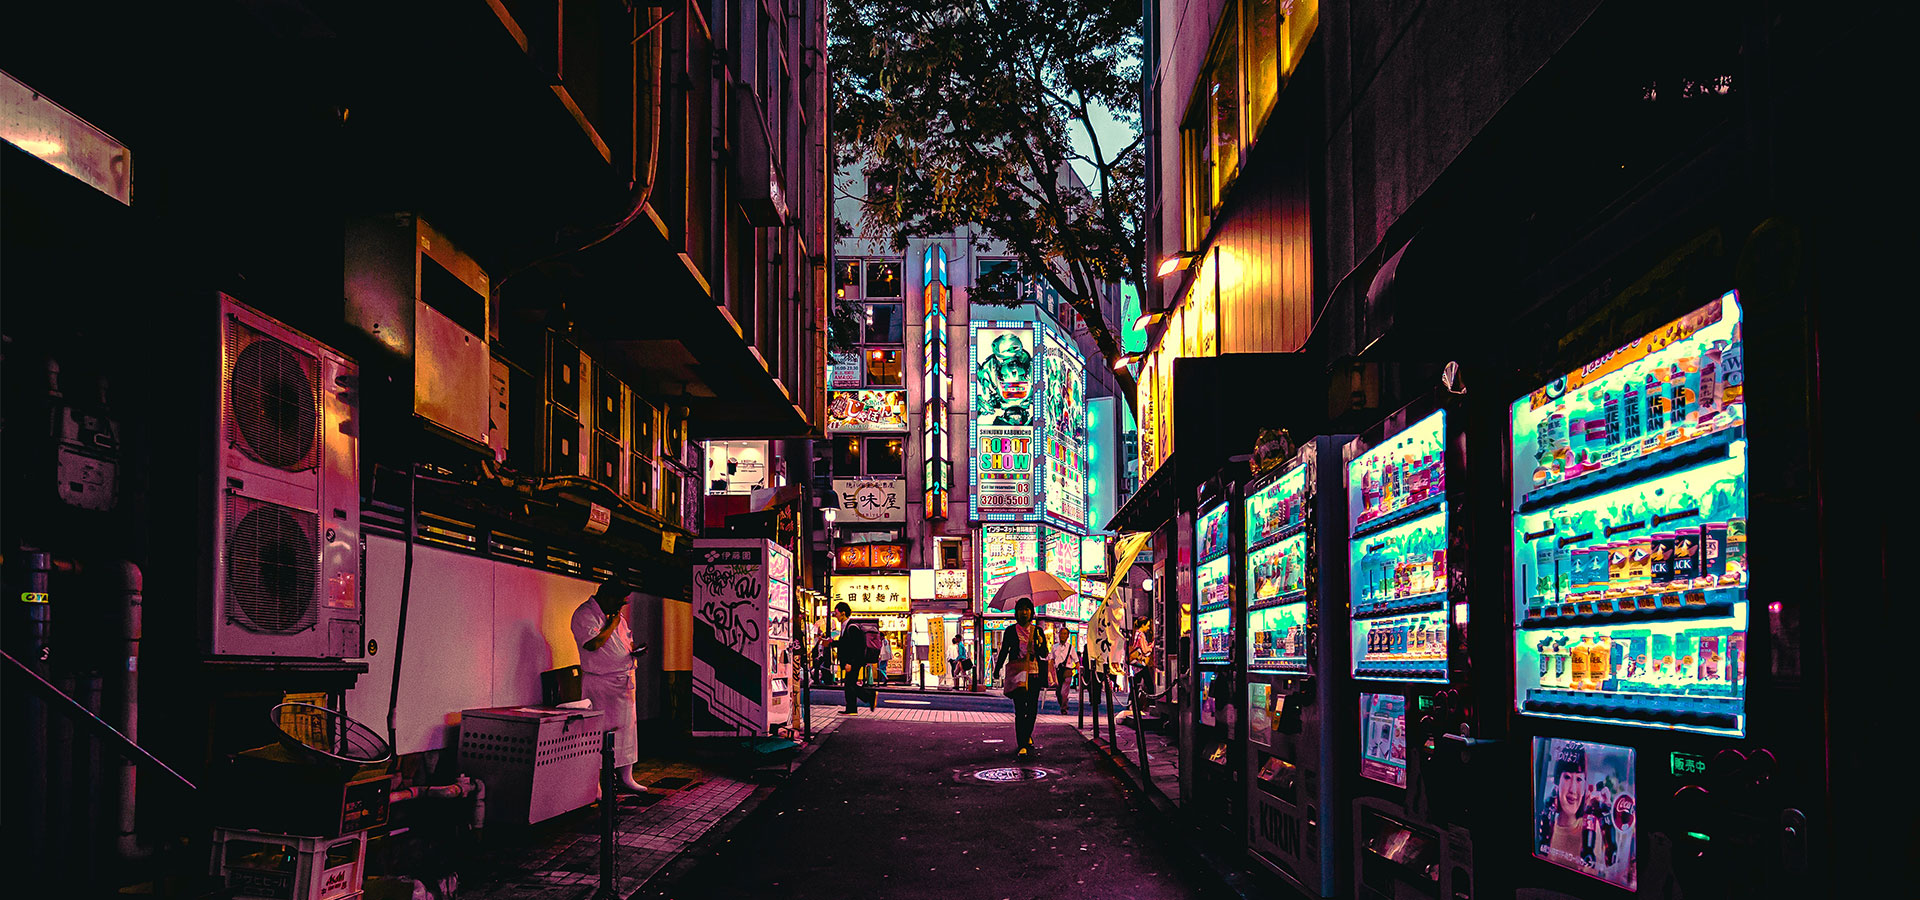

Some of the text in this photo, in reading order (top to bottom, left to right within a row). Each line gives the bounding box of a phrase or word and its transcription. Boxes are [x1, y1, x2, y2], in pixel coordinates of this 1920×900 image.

[932, 303, 939, 316] 5
[932, 362, 939, 375] 4
[933, 421, 939, 435] 3
[981, 438, 1029, 453] ROBOT
[981, 454, 1029, 469] SHOW
[934, 481, 940, 495] 2
[1017, 483, 1029, 493] 03
[842, 492, 901, 511] 旨味屋
[981, 495, 1029, 505] 3200-5500
[1674, 757, 1706, 774] 販売中
[1259, 799, 1301, 861] KIRIN
[325, 871, 346, 886] Asahi
